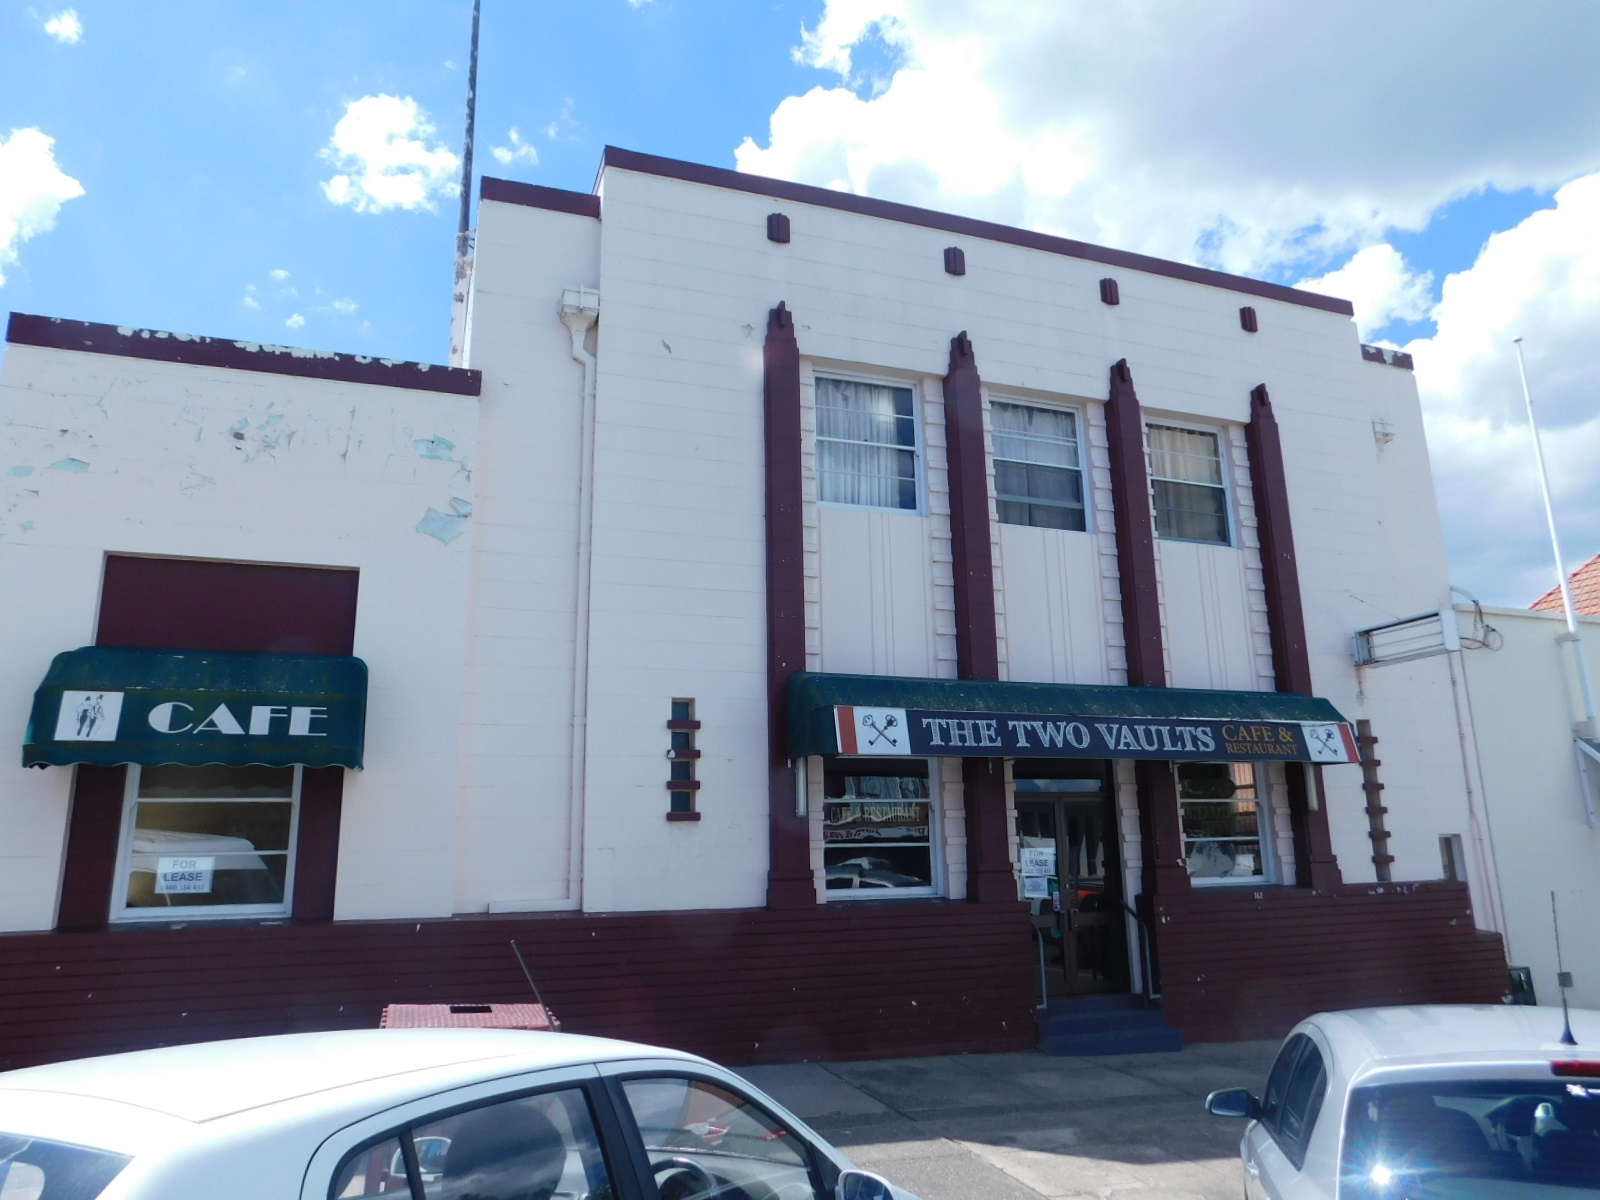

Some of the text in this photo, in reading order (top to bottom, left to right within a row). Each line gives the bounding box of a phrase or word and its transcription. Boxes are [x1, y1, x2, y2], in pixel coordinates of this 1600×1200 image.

[148, 702, 328, 736] CAFE
[922, 718, 1216, 752] THE TWO VAULTS
[1221, 724, 1294, 742] CAFE &
[1225, 742, 1298, 755] RESTAURANT
[830, 806, 852, 822] CAFE
[864, 806, 920, 822] RESTAURANT
[172, 860, 197, 869] FOR
[1025, 859, 1049, 867] LEASE
[164, 872, 203, 882] LEASE
